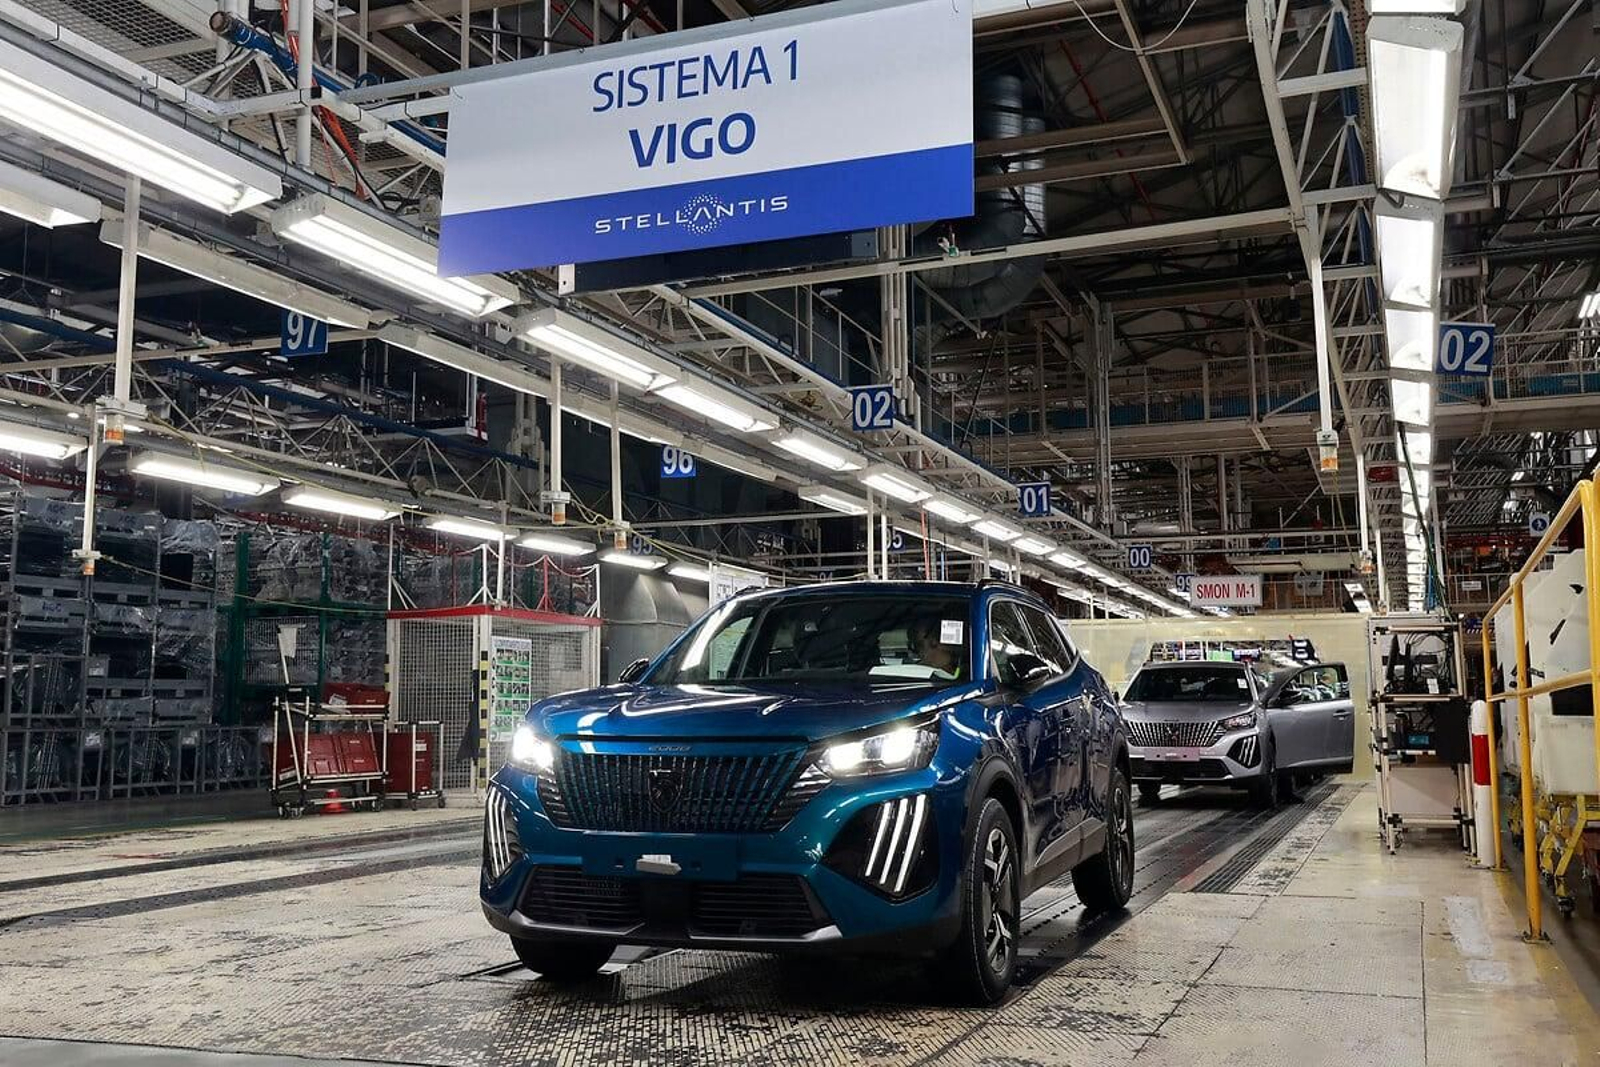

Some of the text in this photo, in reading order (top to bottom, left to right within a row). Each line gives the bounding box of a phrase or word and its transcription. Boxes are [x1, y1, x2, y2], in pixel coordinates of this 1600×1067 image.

[592, 39, 798, 112] SISTEMA 1
[628, 112, 756, 168] VIGO
[594, 195, 789, 234] STELLANTIS
[287, 311, 318, 350] 97
[1440, 328, 1490, 373] 02
[855, 390, 891, 428] 02
[663, 446, 694, 475] 96
[1023, 486, 1048, 513] 01
[1130, 547, 1150, 567] 00
[1196, 582, 1256, 600] SMON M-1
